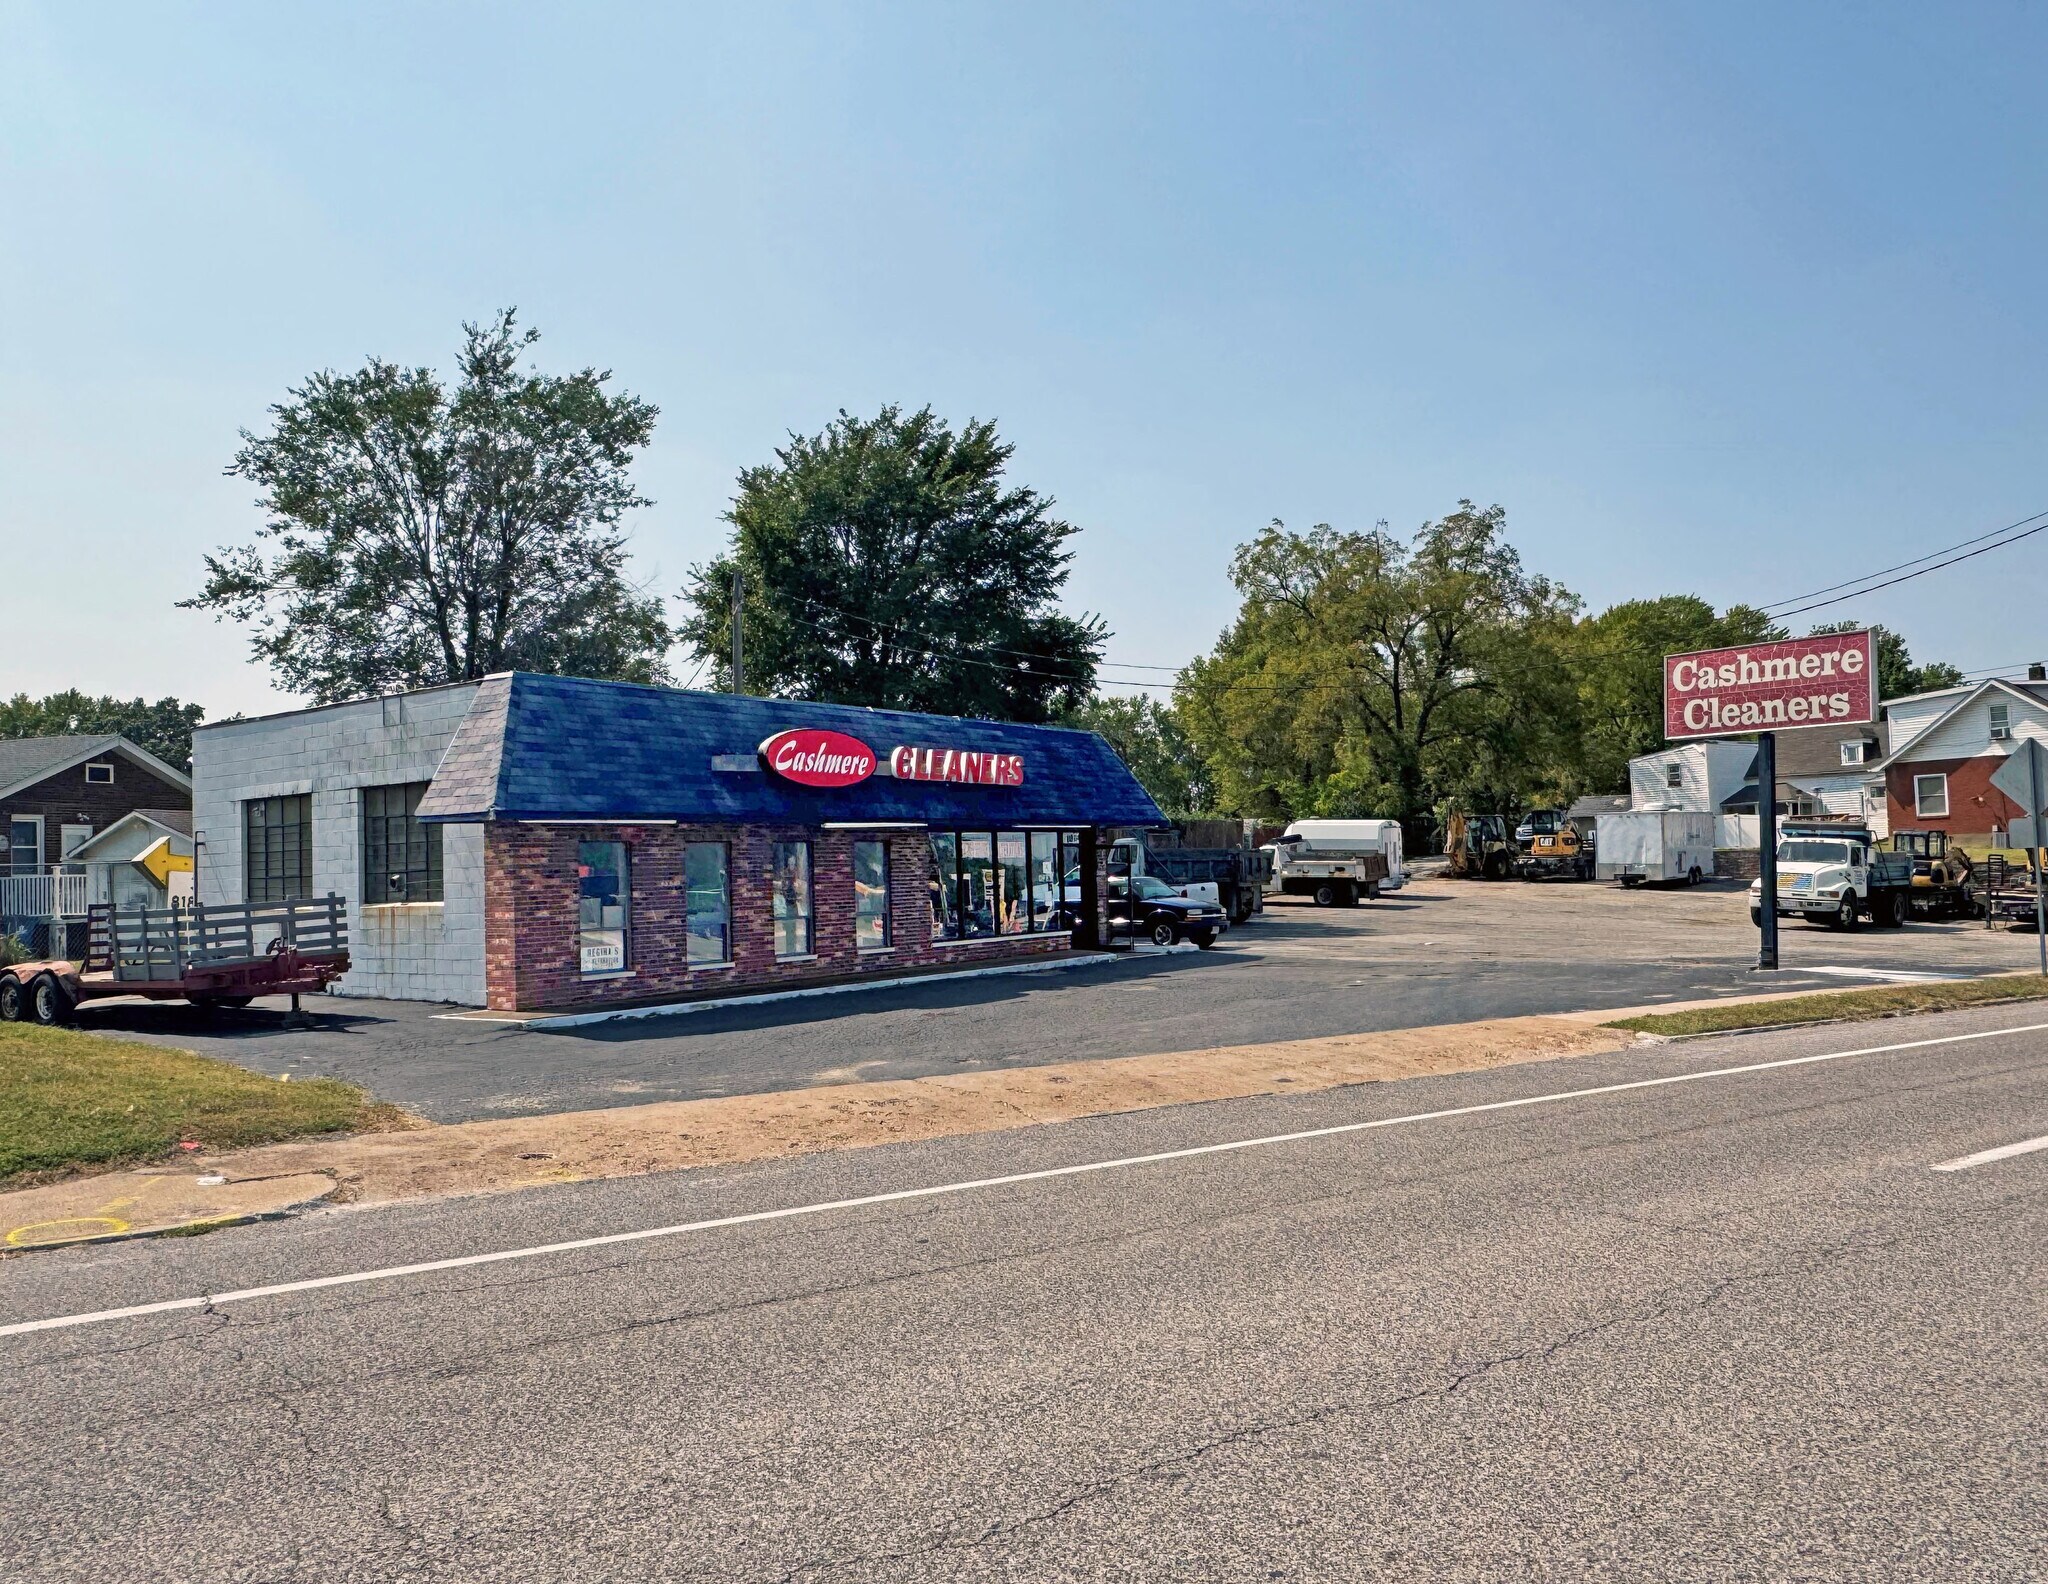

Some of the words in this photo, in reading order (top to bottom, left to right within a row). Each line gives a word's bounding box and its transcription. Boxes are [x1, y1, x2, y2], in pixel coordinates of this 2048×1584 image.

[1672, 649, 1864, 691] Cashmere
[1683, 692, 1850, 729] Cleaners
[775, 740, 869, 776] Cashmere
[891, 746, 1024, 786] CLEANERS
